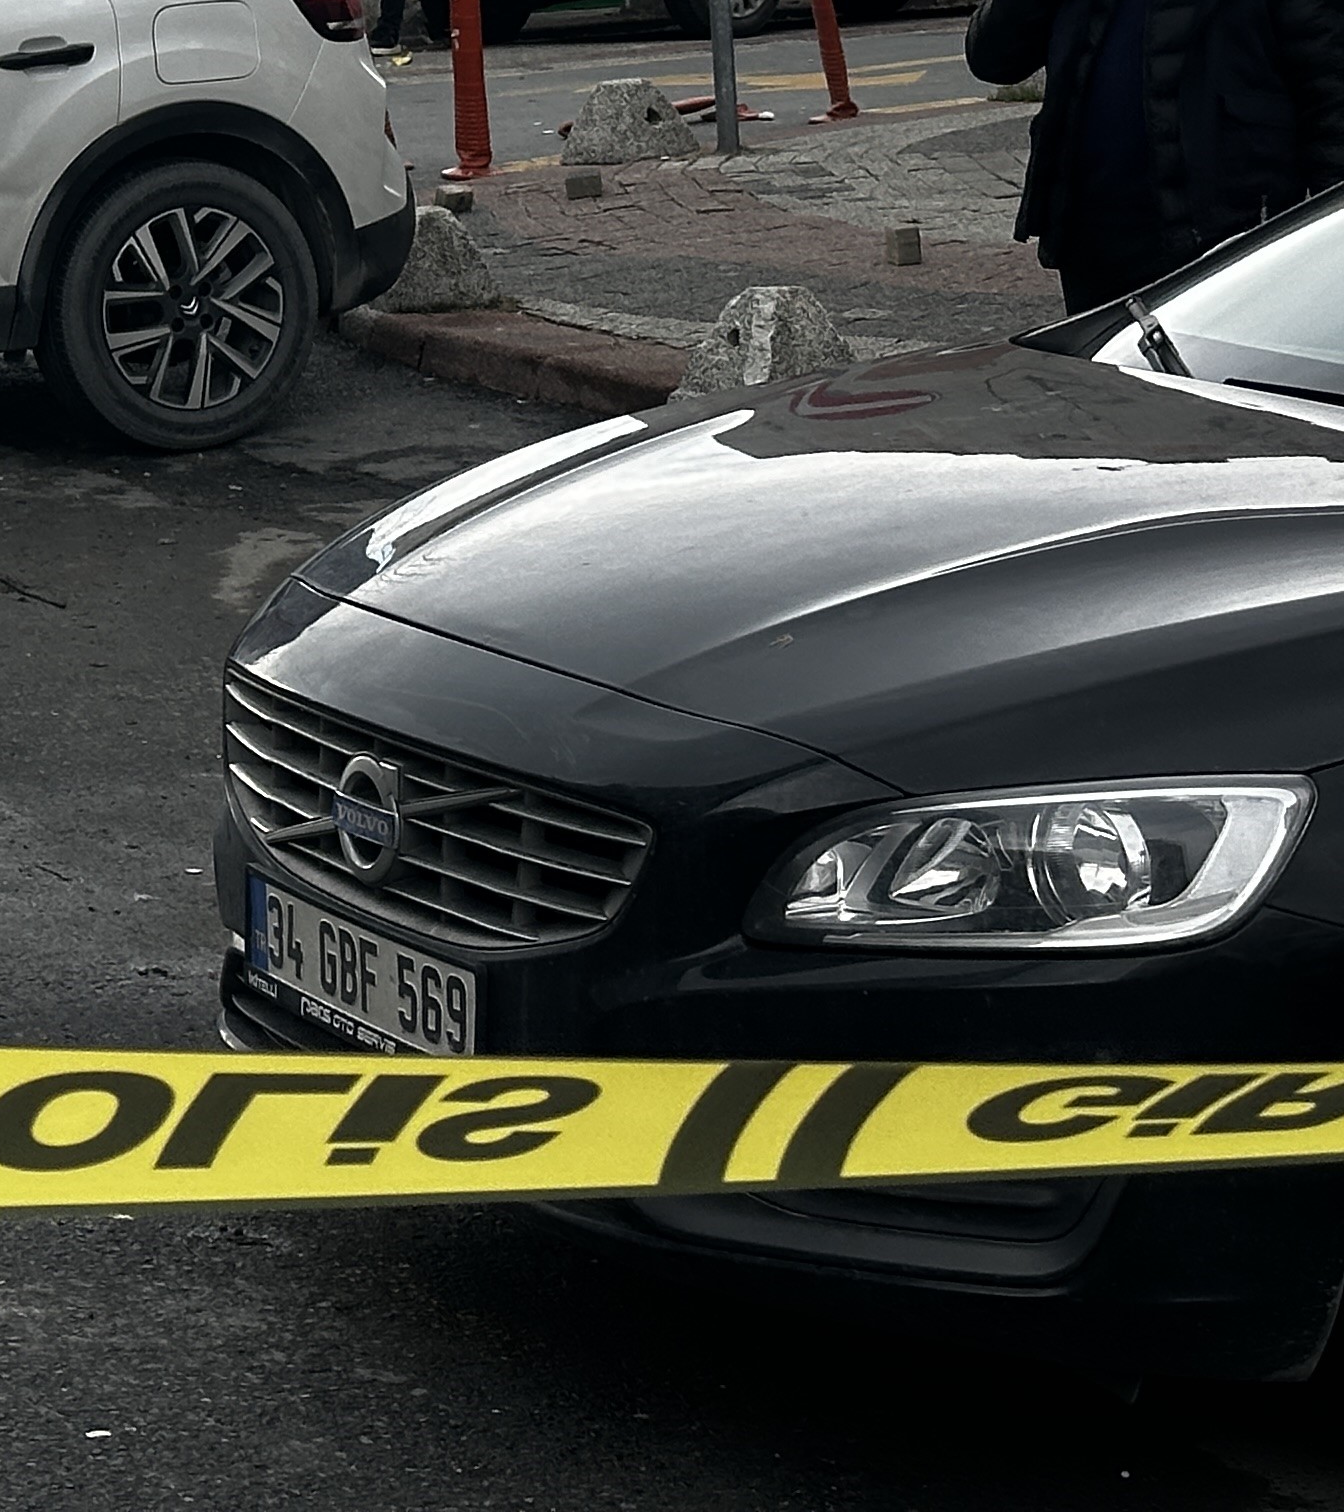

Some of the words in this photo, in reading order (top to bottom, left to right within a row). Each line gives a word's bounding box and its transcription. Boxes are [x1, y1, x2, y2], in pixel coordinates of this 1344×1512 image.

[336, 802, 389, 836] VOLVO
[268, 892, 303, 981] 34
[319, 918, 379, 1014] GBF
[396, 951, 467, 1054] 569
